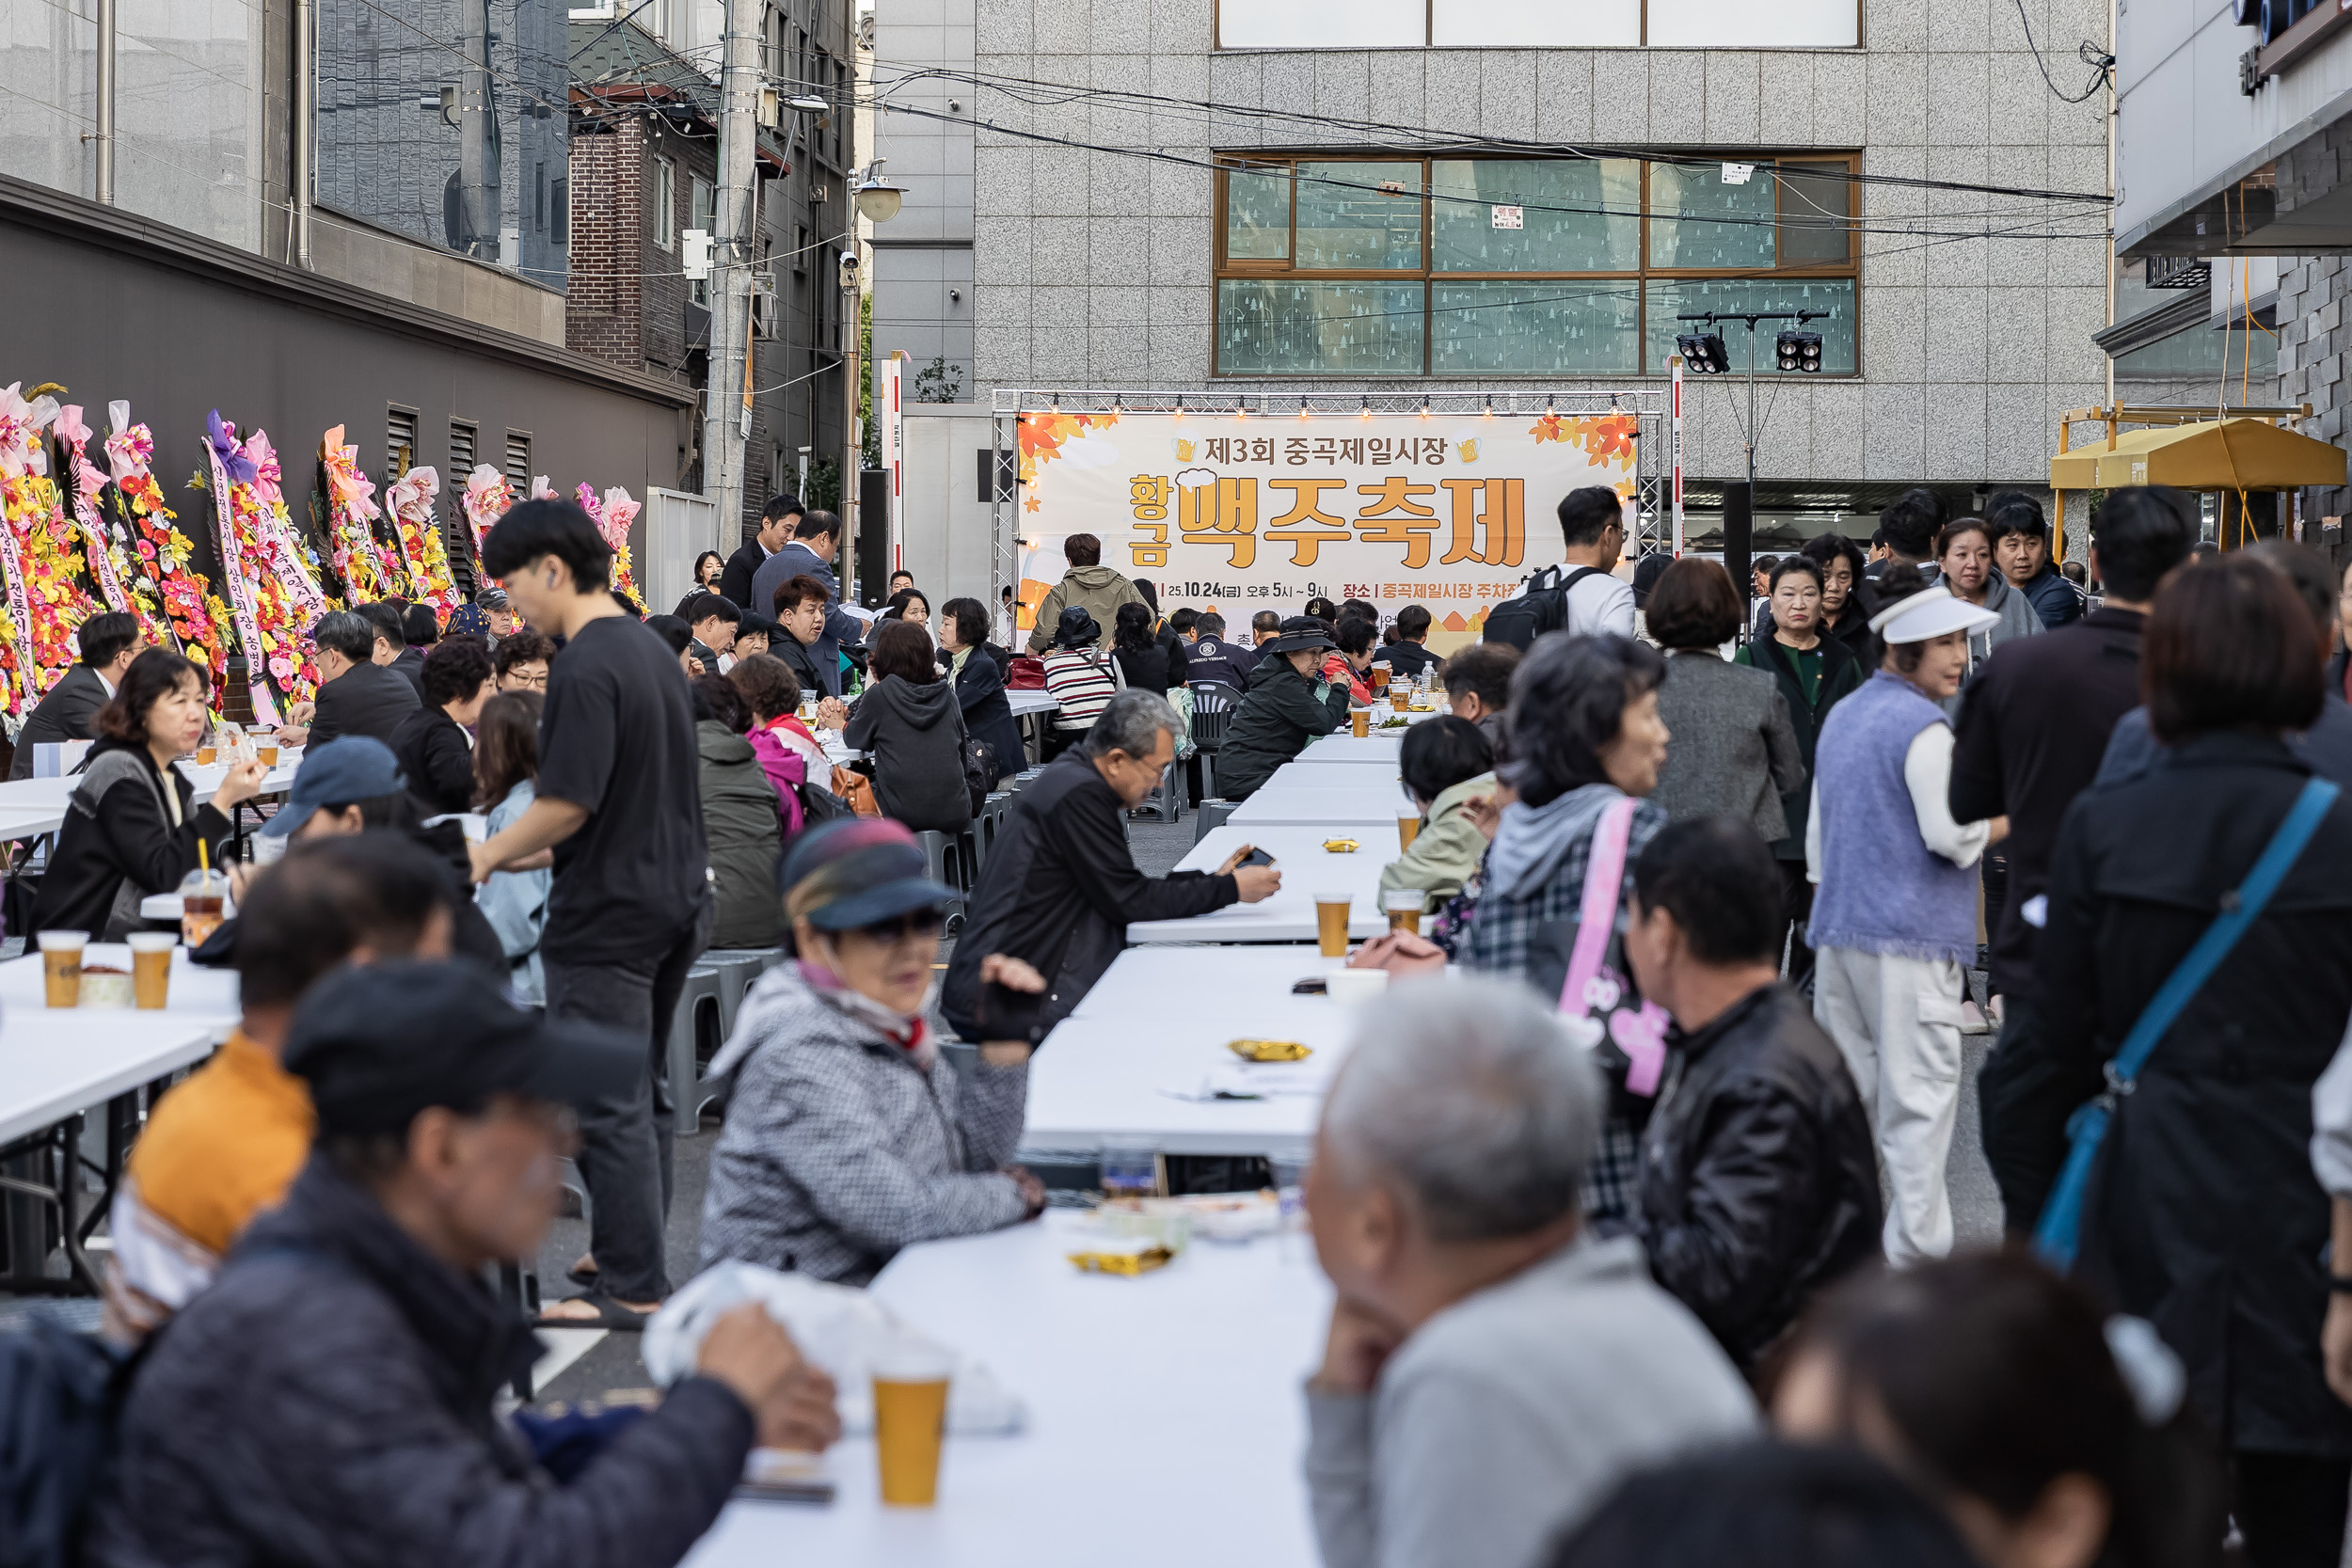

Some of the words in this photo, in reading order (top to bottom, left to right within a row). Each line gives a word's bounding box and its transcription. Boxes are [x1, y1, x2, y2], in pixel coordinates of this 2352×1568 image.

[1205, 437, 1275, 466] 제3회
[1283, 437, 1448, 466] 중곡제일시장
[1128, 474, 1174, 567] 황금
[1175, 468, 1526, 569] 맥주축제
[1168, 581, 1241, 598] 25.10.24(금)
[1247, 585, 1270, 597] 오후
[1273, 582, 1293, 597] 5시
[1307, 581, 1327, 597] 9시
[1343, 583, 1371, 598] 장소
[1382, 582, 1473, 599] 중곡제일시장
